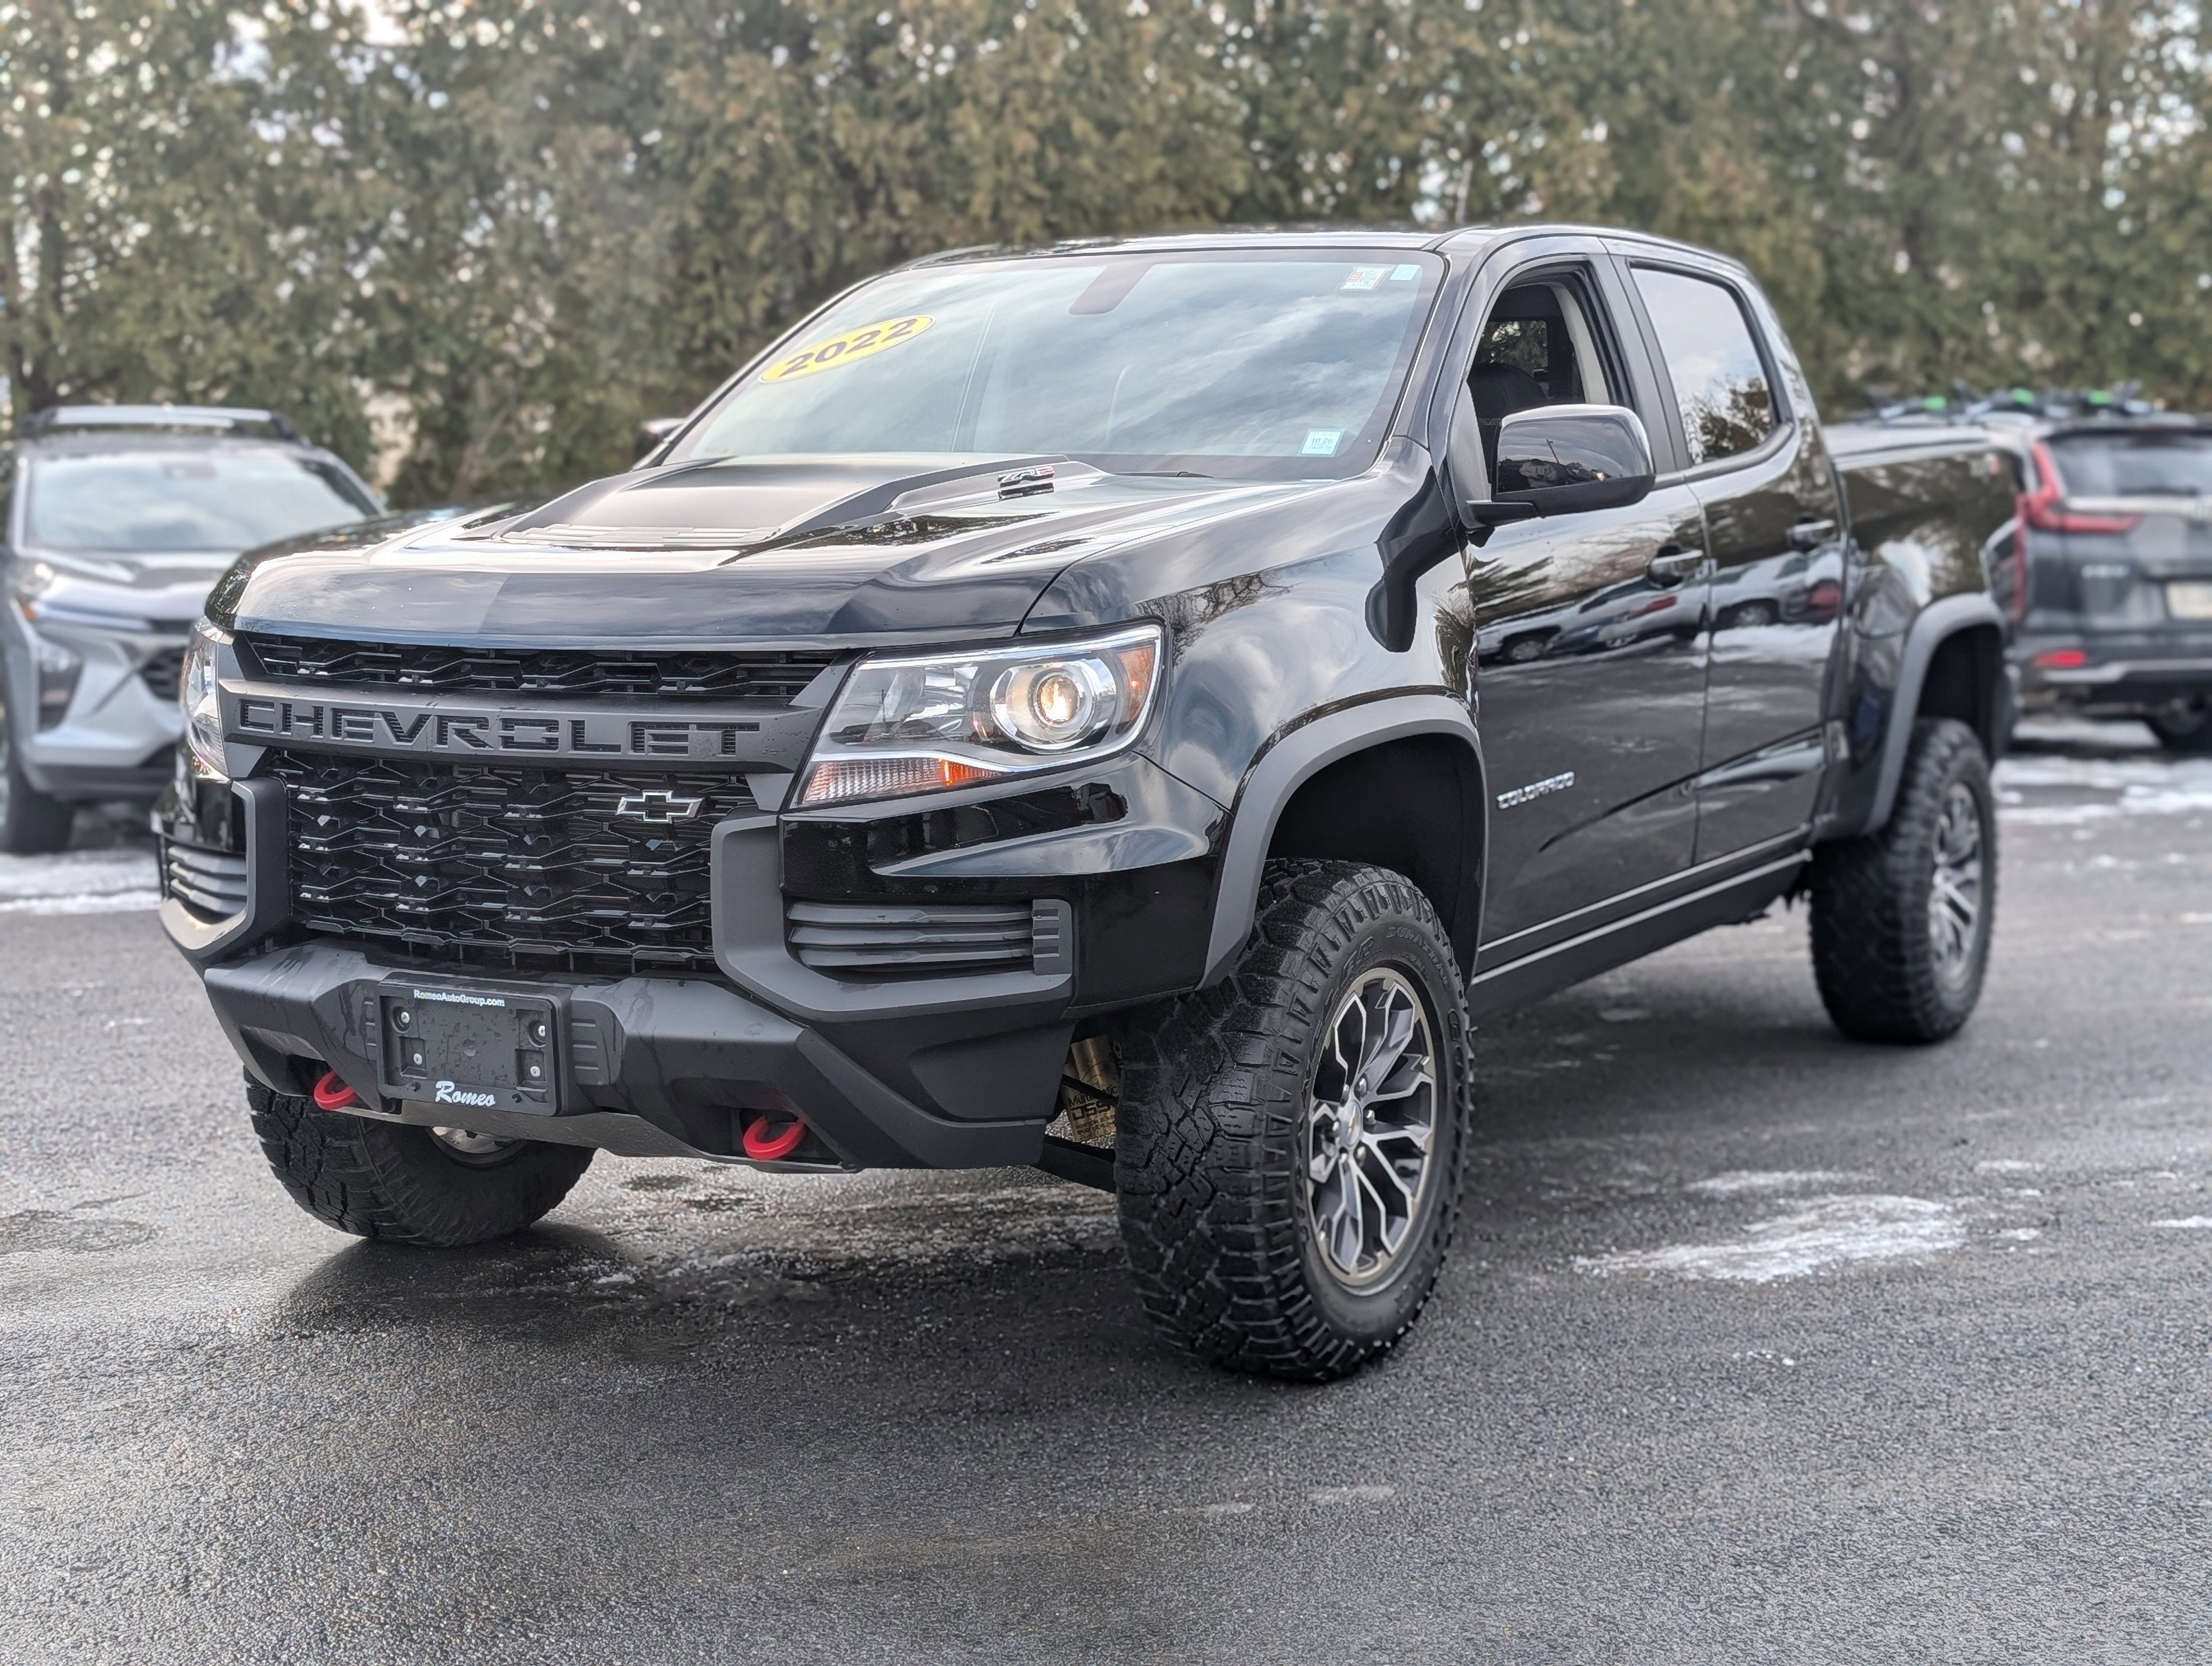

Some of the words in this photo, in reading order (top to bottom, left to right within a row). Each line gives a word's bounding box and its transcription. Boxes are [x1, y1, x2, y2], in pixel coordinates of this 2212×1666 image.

[778, 318, 918, 378] 2022
[238, 699, 760, 757] CHEVROLET
[413, 989, 505, 1007] RomeoAutoGroup.com
[435, 1081, 496, 1107] Romeo
